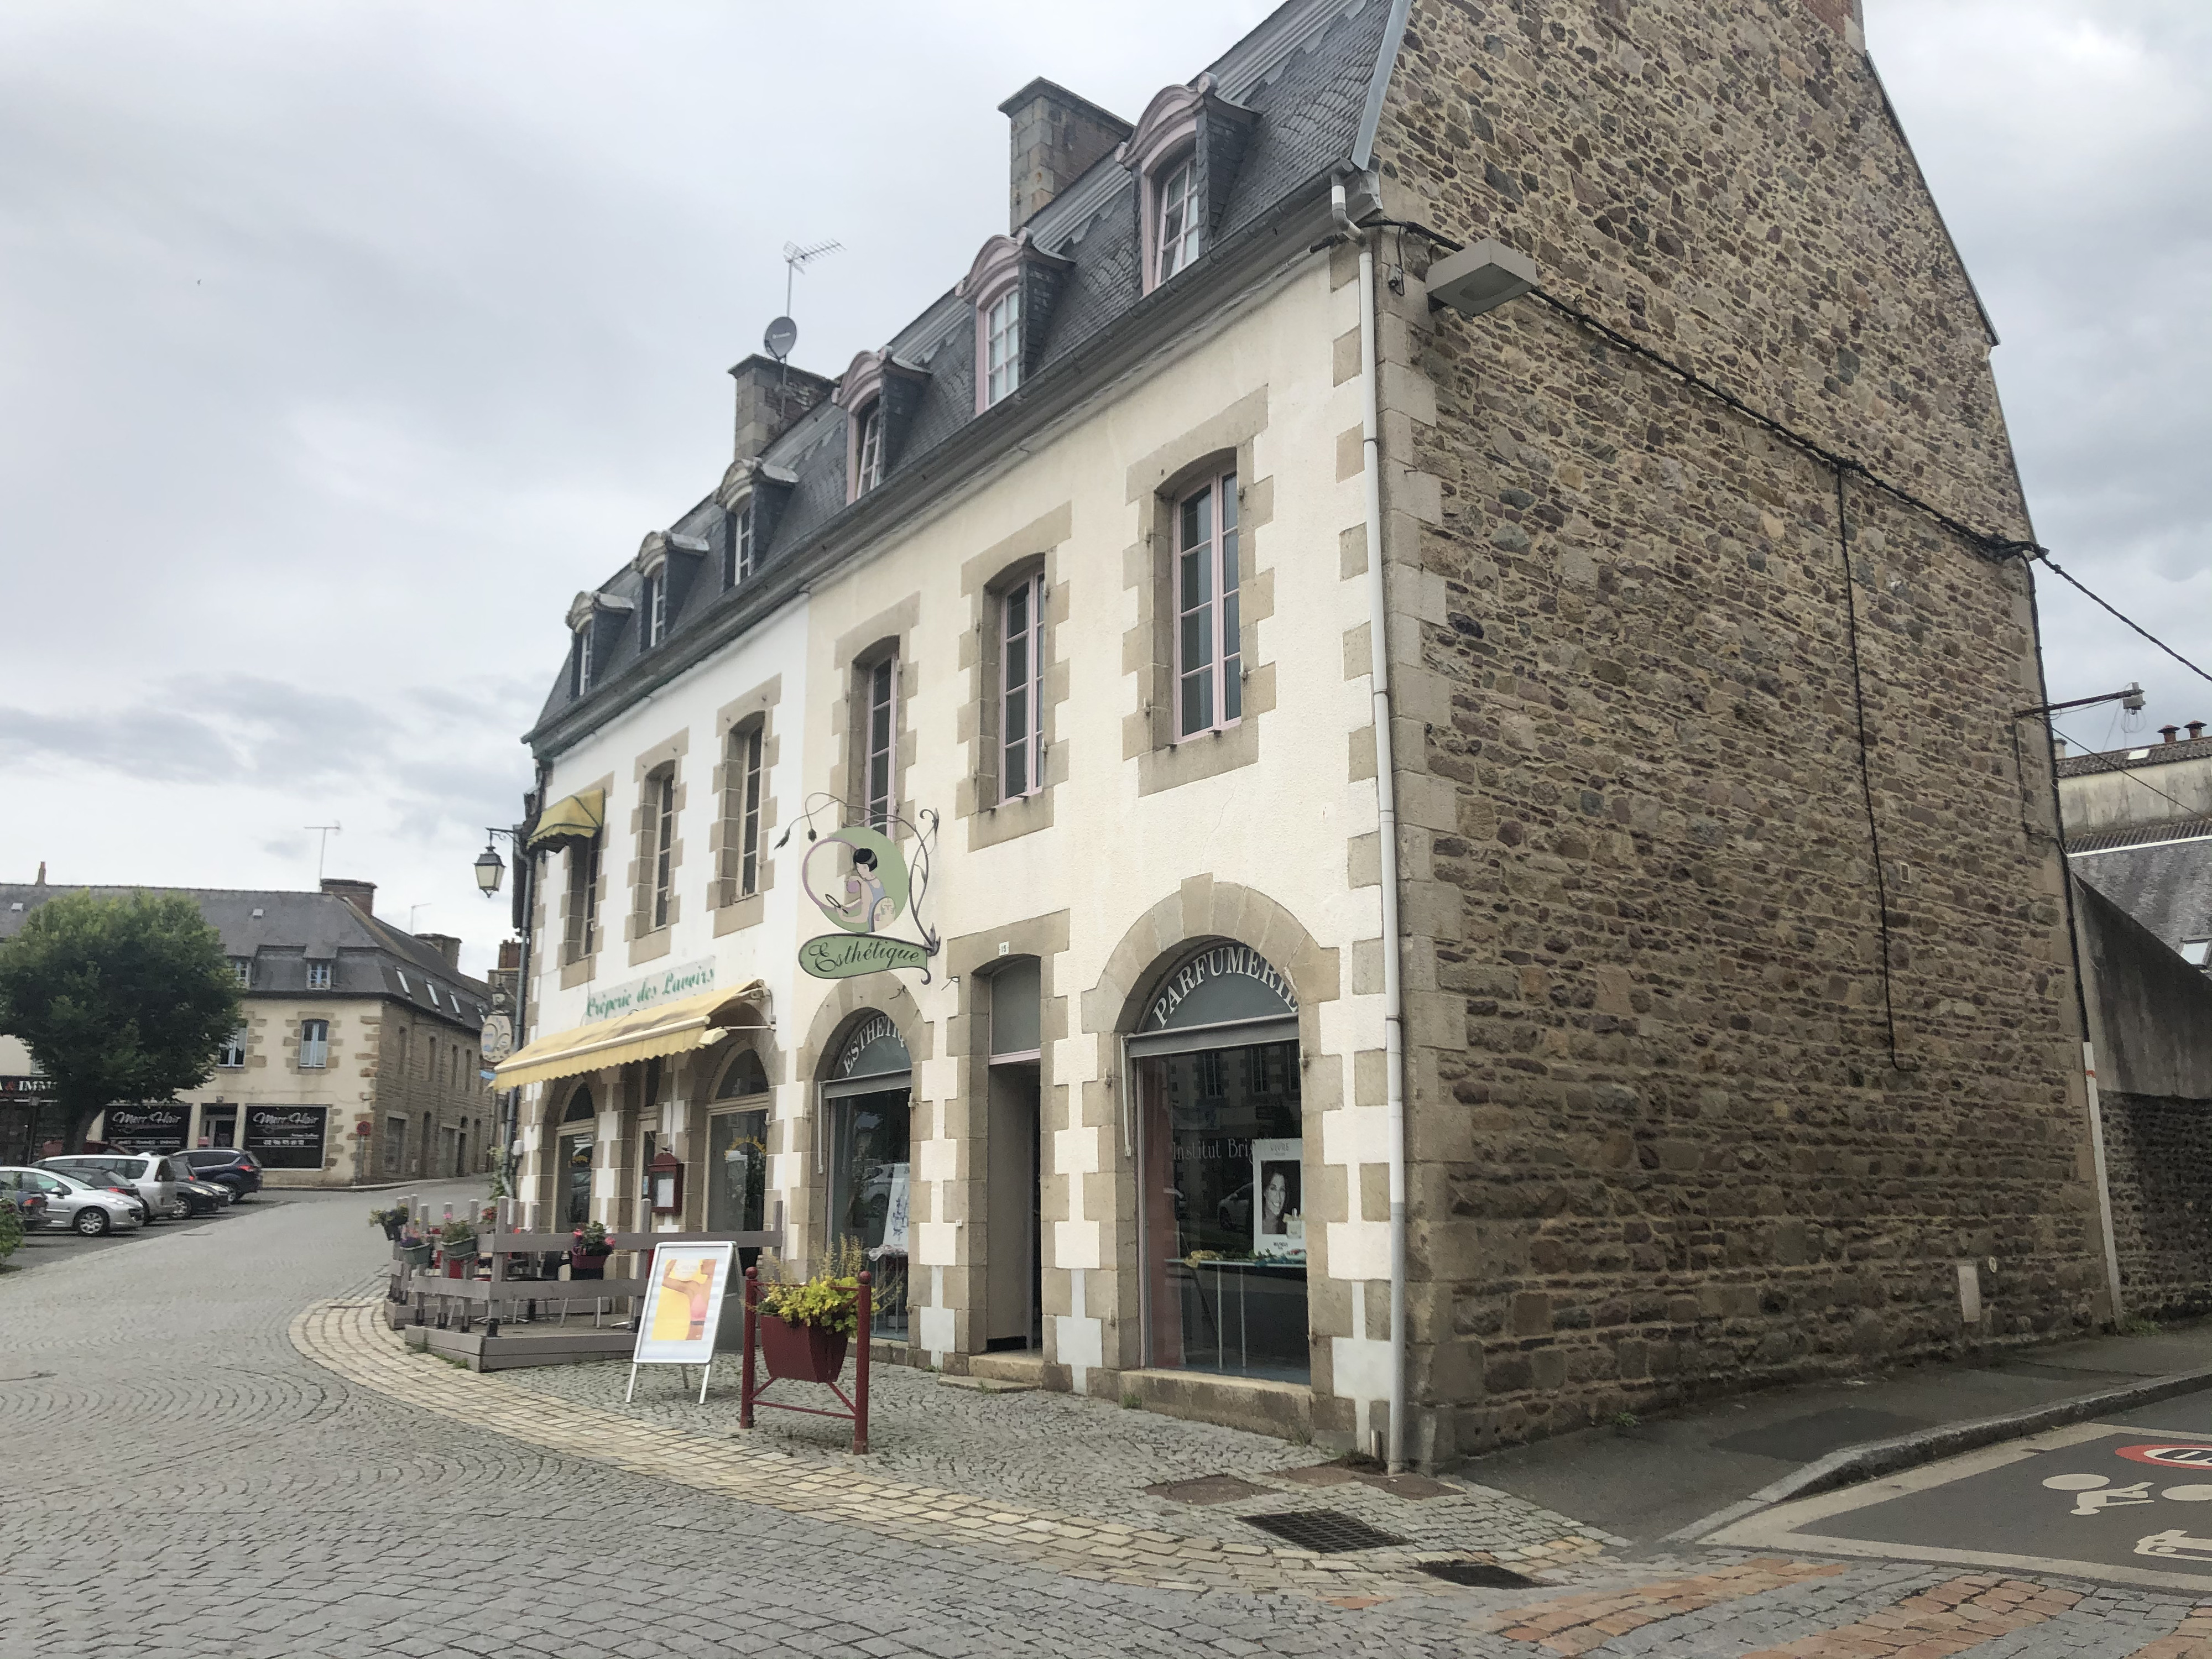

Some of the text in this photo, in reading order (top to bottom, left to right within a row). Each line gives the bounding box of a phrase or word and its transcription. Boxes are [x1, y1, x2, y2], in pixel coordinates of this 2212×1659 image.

[808, 941, 920, 972] Esthétique
[1001, 945, 1006, 953] 15
[19, 1080, 58, 1091] IMM
[1173, 1139, 1222, 1160] Institut
